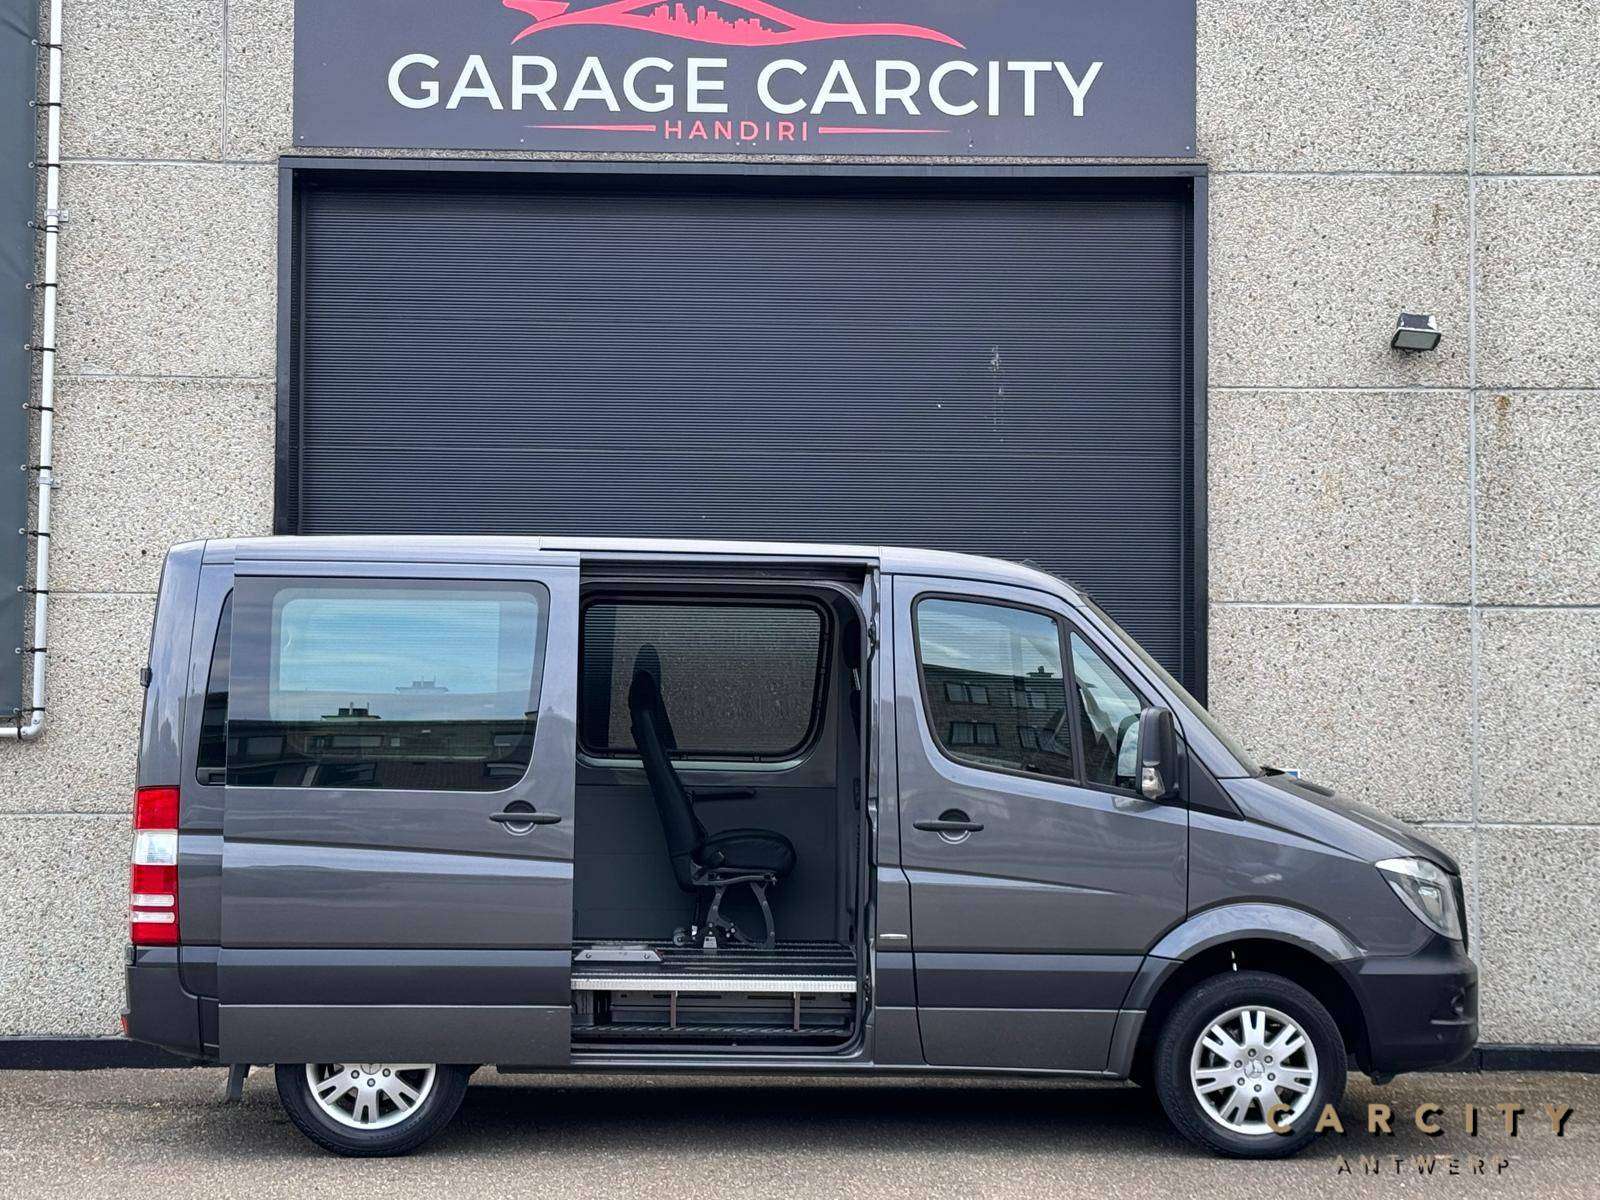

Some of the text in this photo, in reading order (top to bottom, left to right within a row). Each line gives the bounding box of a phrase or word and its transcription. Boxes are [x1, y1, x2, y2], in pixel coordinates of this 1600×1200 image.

[387, 53, 1104, 117] GARAGE CARCITY
[664, 119, 808, 141] HANDIRI
